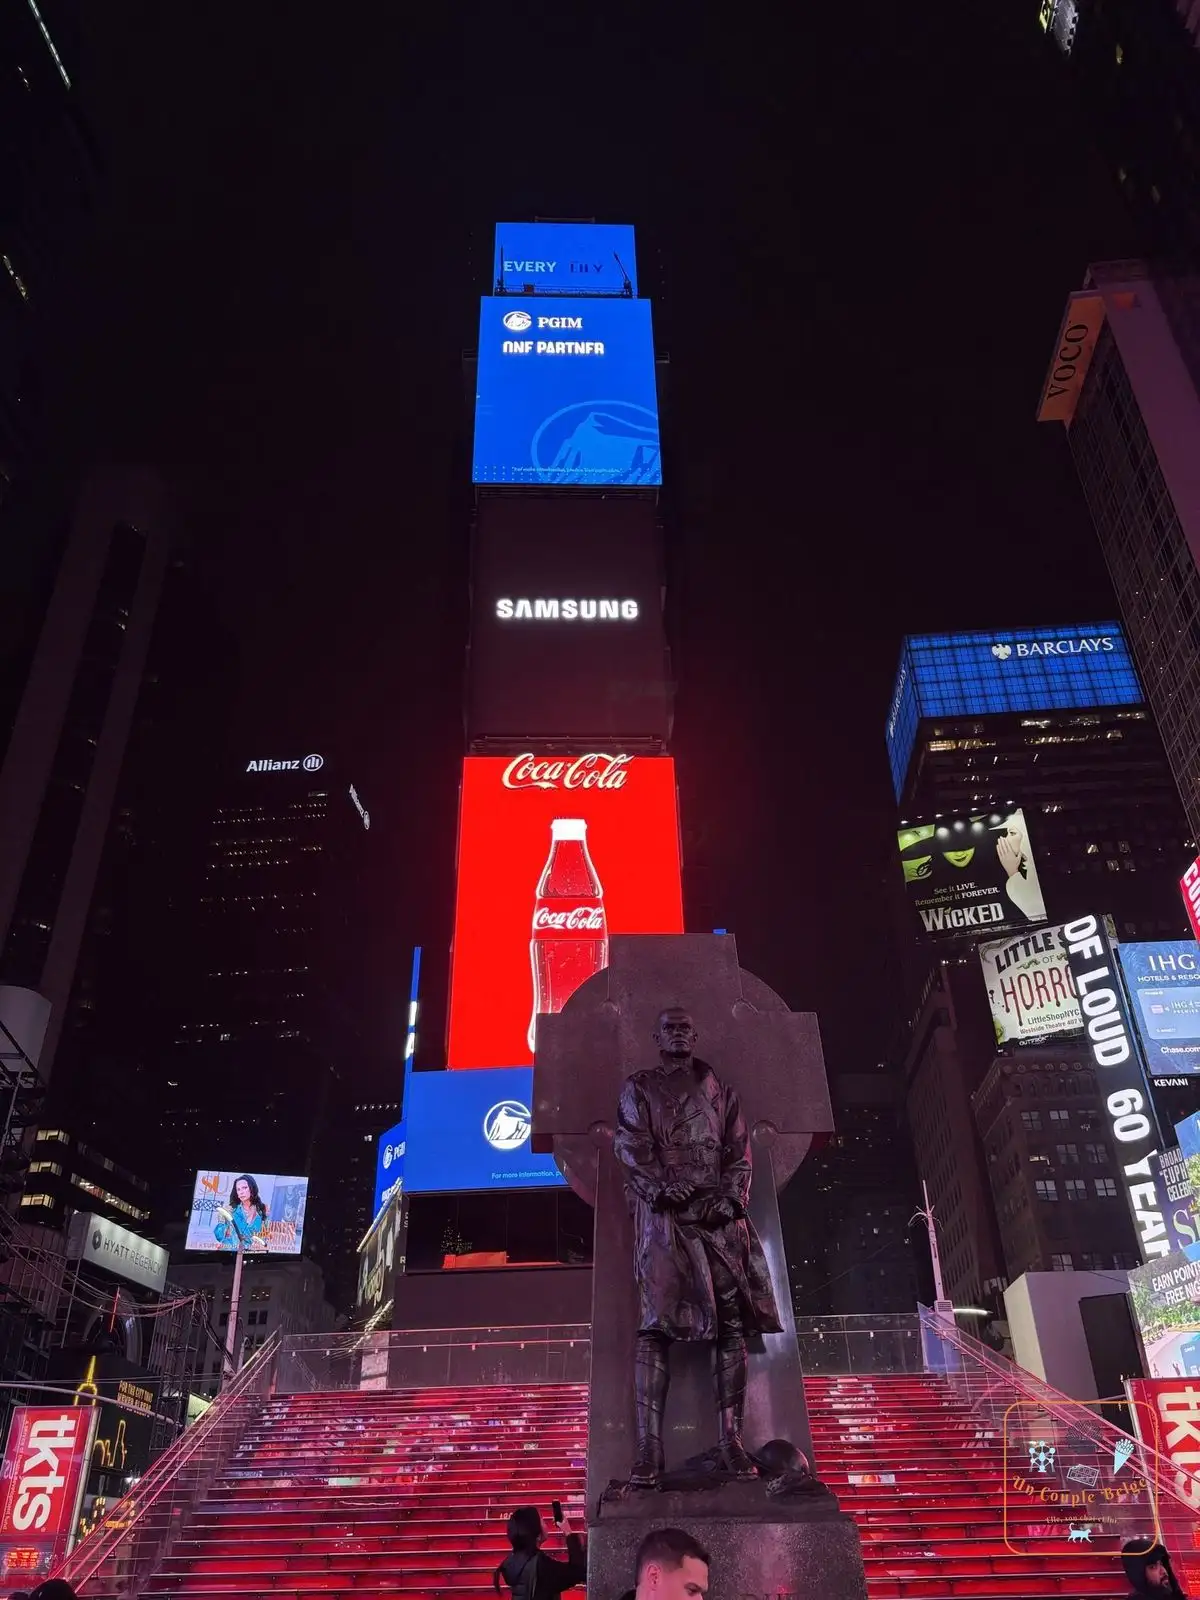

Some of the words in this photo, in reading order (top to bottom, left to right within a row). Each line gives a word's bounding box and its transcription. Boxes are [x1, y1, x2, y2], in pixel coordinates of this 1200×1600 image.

[504, 260, 557, 273] EVERY
[537, 316, 583, 329] PGIM
[496, 598, 639, 620] SAMSUNG
[1016, 637, 1114, 657] BARCLAYS
[246, 759, 300, 772] Allianz
[502, 753, 636, 790] Coca-Cola
[915, 895, 953, 907] Remember
[934, 887, 948, 895] See
[532, 906, 605, 929] Coca-Cola
[1064, 915, 1104, 959] OF
[995, 931, 1056, 974] LITTLE
[1042, 955, 1055, 964] OF
[1148, 954, 1194, 971] IHG
[1020, 1025, 1045, 1034] Westside
[1045, 1021, 1066, 1031] Theatre
[1067, 1018, 1078, 1026] 407
[1076, 966, 1130, 1067] LOUD
[1154, 1078, 1188, 1087] KEVANI
[1107, 1088, 1150, 1142] 60
[491, 1172, 502, 1180] For
[103, 1238, 130, 1259] HYATT
[130, 1249, 162, 1276] REGENCY
[1152, 1270, 1175, 1292] EARN
[1173, 1261, 1200, 1285] POINT
[1165, 1284, 1187, 1306] FREE
[12, 1415, 75, 1531] tkts
